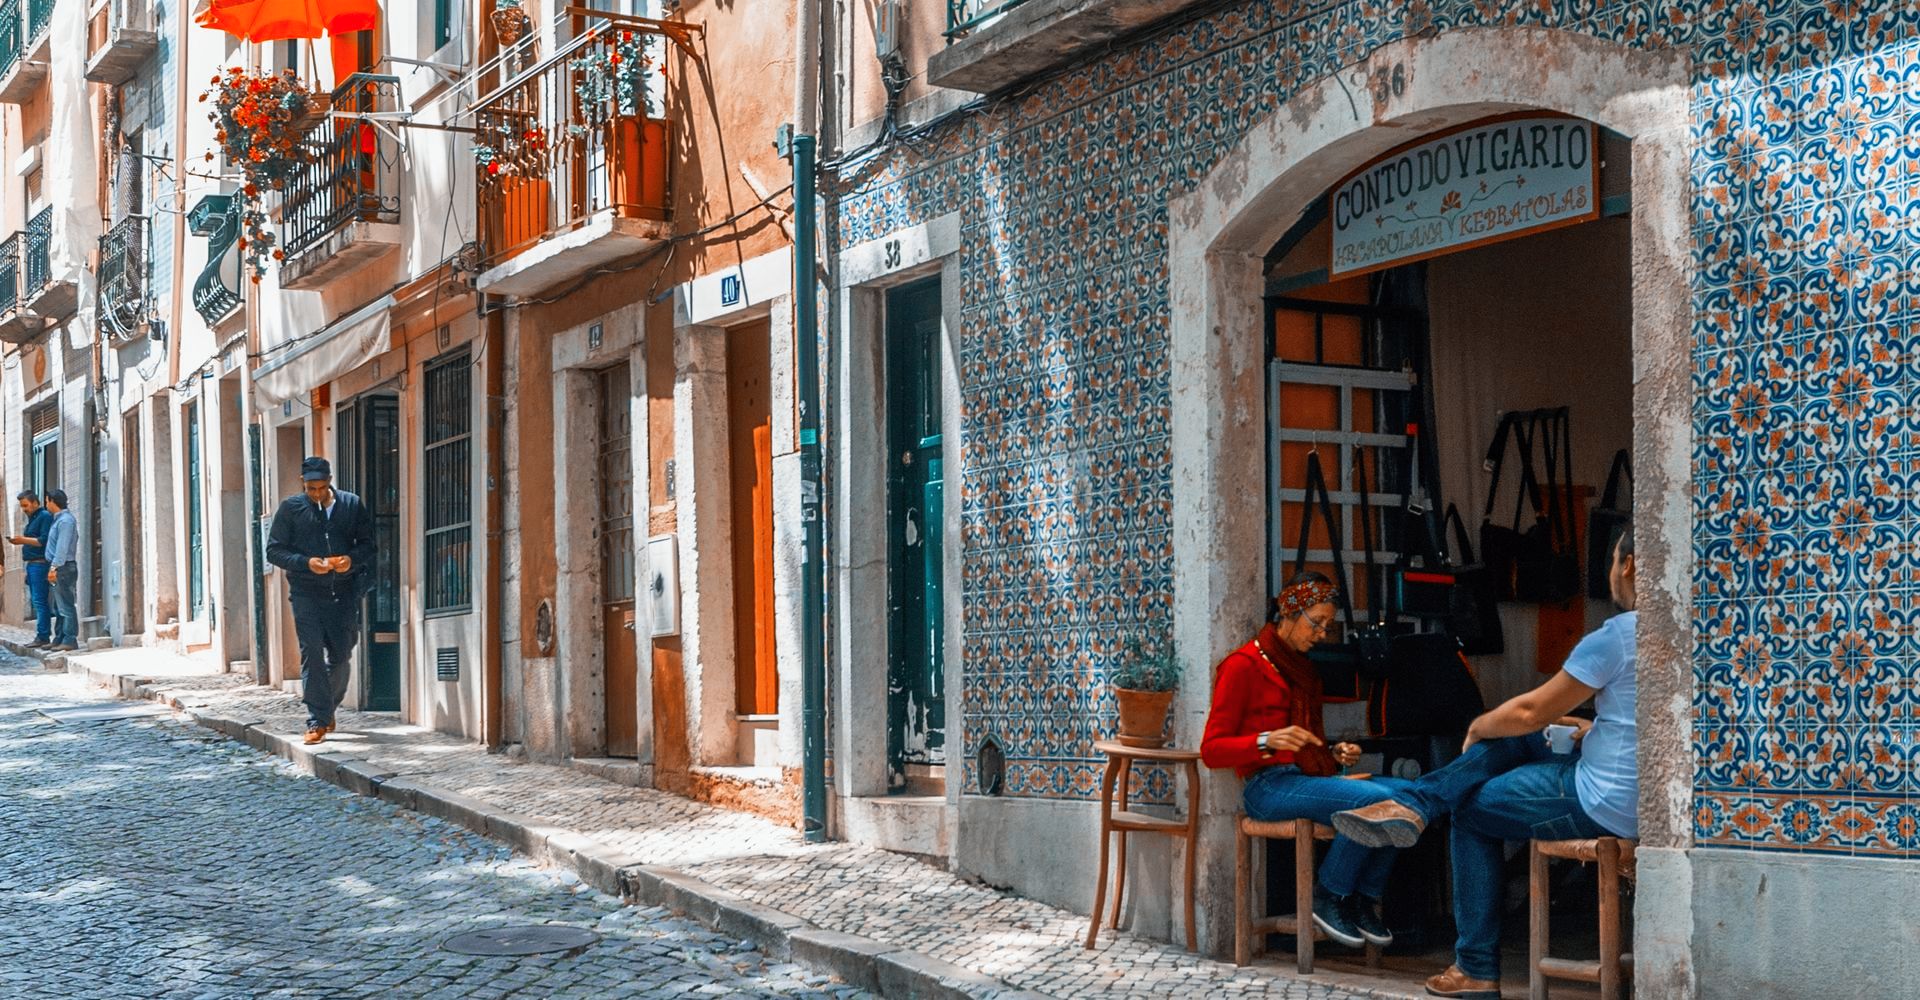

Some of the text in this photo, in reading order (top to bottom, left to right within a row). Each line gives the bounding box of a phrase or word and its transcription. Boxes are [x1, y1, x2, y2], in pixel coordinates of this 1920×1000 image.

[1376, 63, 1405, 102] 36
[1336, 125, 1587, 231] CONTO DO VIGARIO
[1459, 185, 1588, 237] KEBRATOLAS
[885, 239, 901, 269] 38
[723, 277, 735, 302] 40
